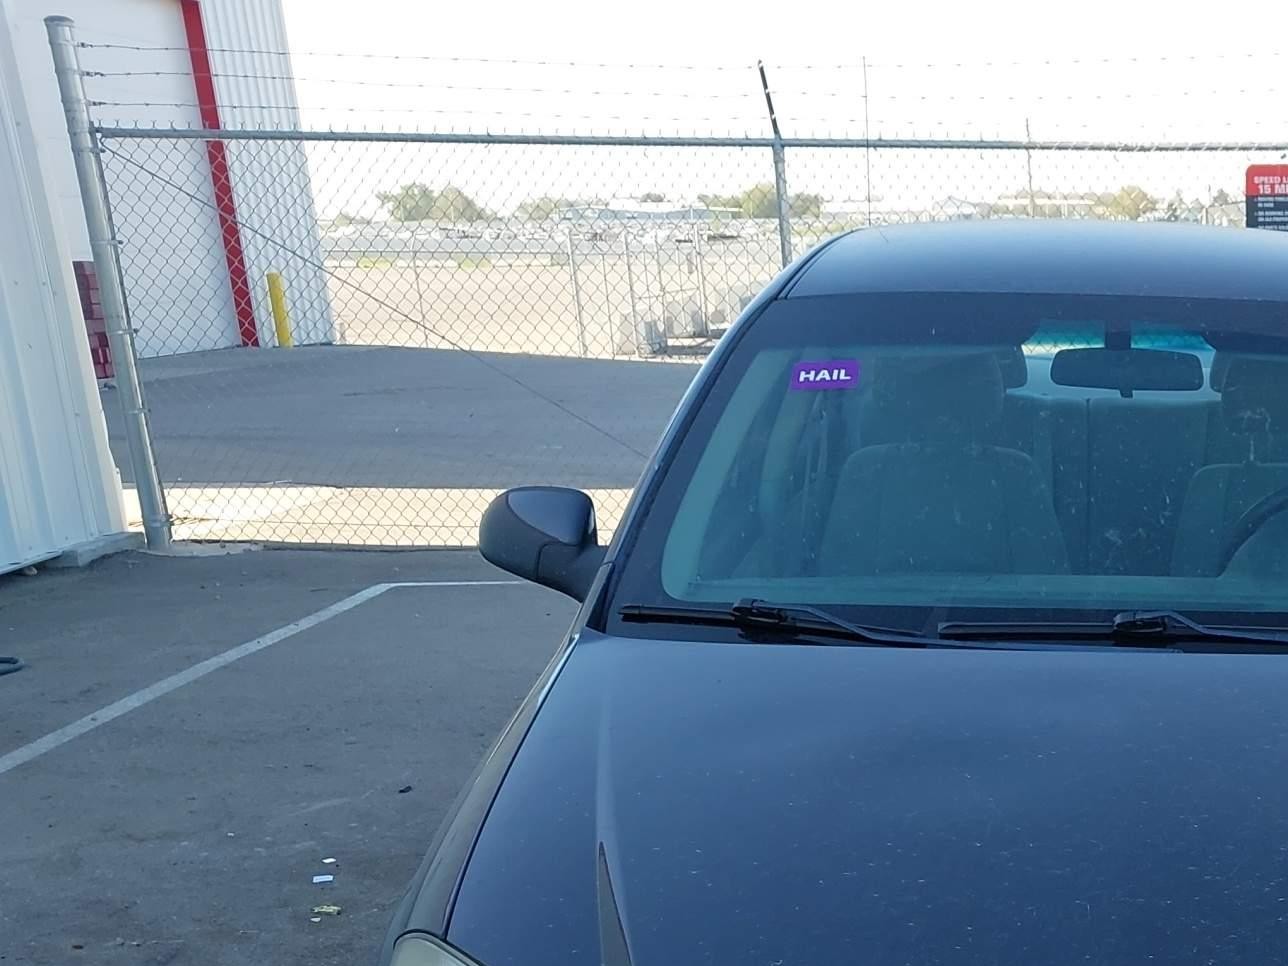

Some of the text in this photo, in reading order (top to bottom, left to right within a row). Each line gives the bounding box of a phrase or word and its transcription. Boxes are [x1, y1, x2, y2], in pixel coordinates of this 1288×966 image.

[1253, 176, 1281, 184] SPEED
[1258, 184, 1272, 194] 15
[798, 368, 852, 382] HAIL
